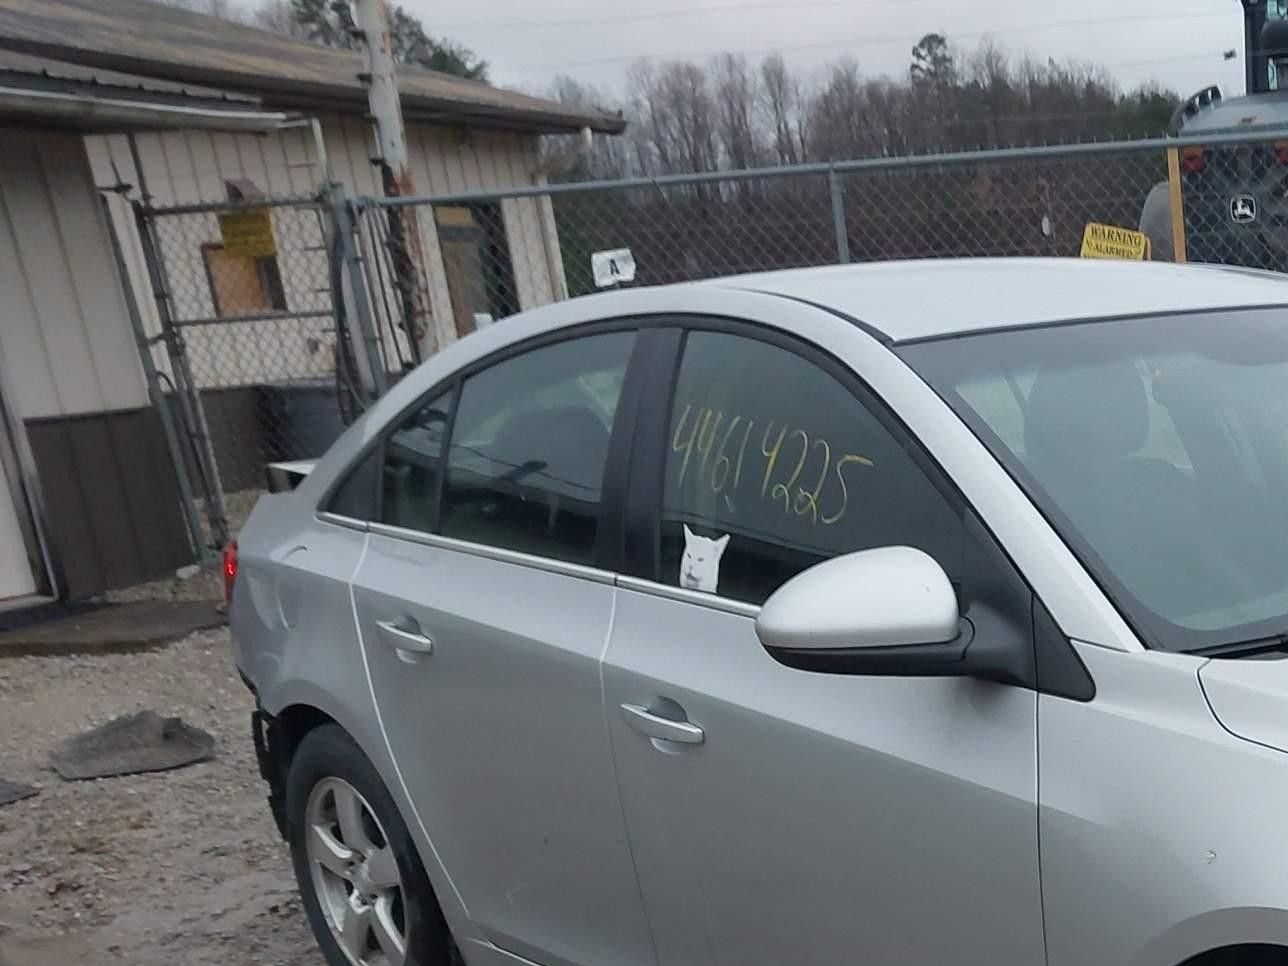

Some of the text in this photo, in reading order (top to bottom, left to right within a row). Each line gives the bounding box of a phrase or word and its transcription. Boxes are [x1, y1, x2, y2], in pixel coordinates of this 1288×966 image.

[1090, 225, 1142, 247] WARNING
[610, 258, 621, 276] A
[673, 404, 874, 526] 44614225
